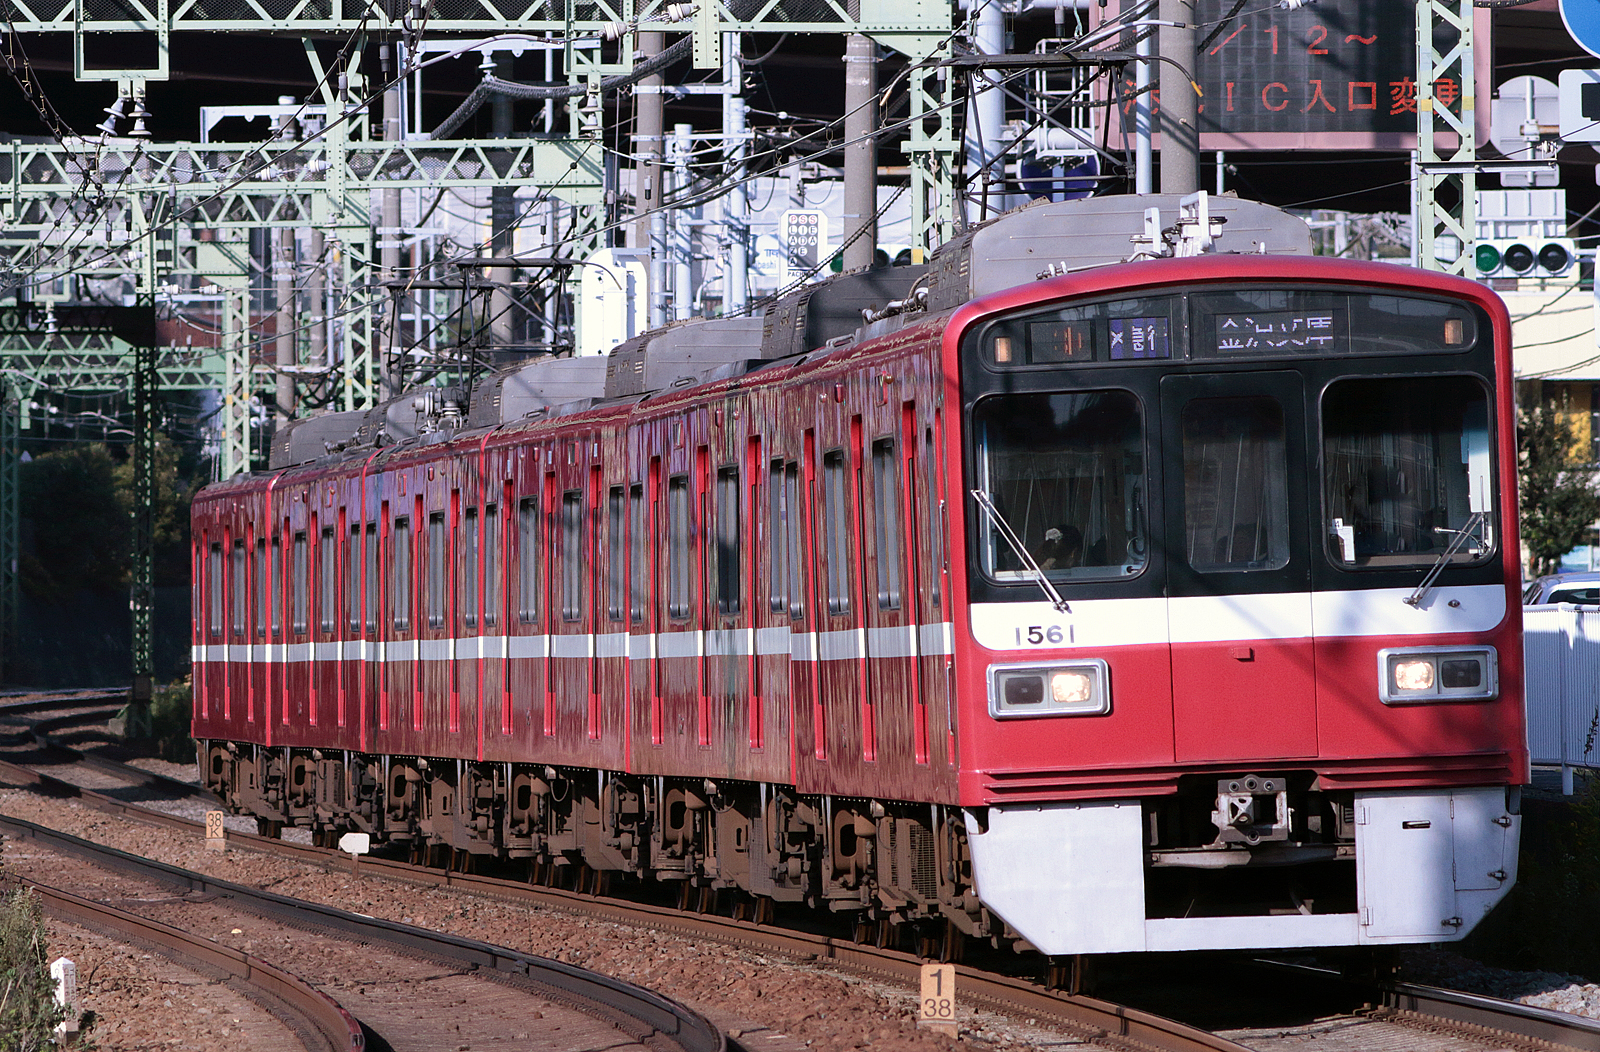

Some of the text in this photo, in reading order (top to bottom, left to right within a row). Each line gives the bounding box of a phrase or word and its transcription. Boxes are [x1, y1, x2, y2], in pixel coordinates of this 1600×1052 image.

[1015, 624, 1075, 646] 1561
[208, 813, 222, 827] 38
[210, 827, 219, 837] K
[929, 968, 942, 997] 1
[924, 998, 951, 1017] 38
